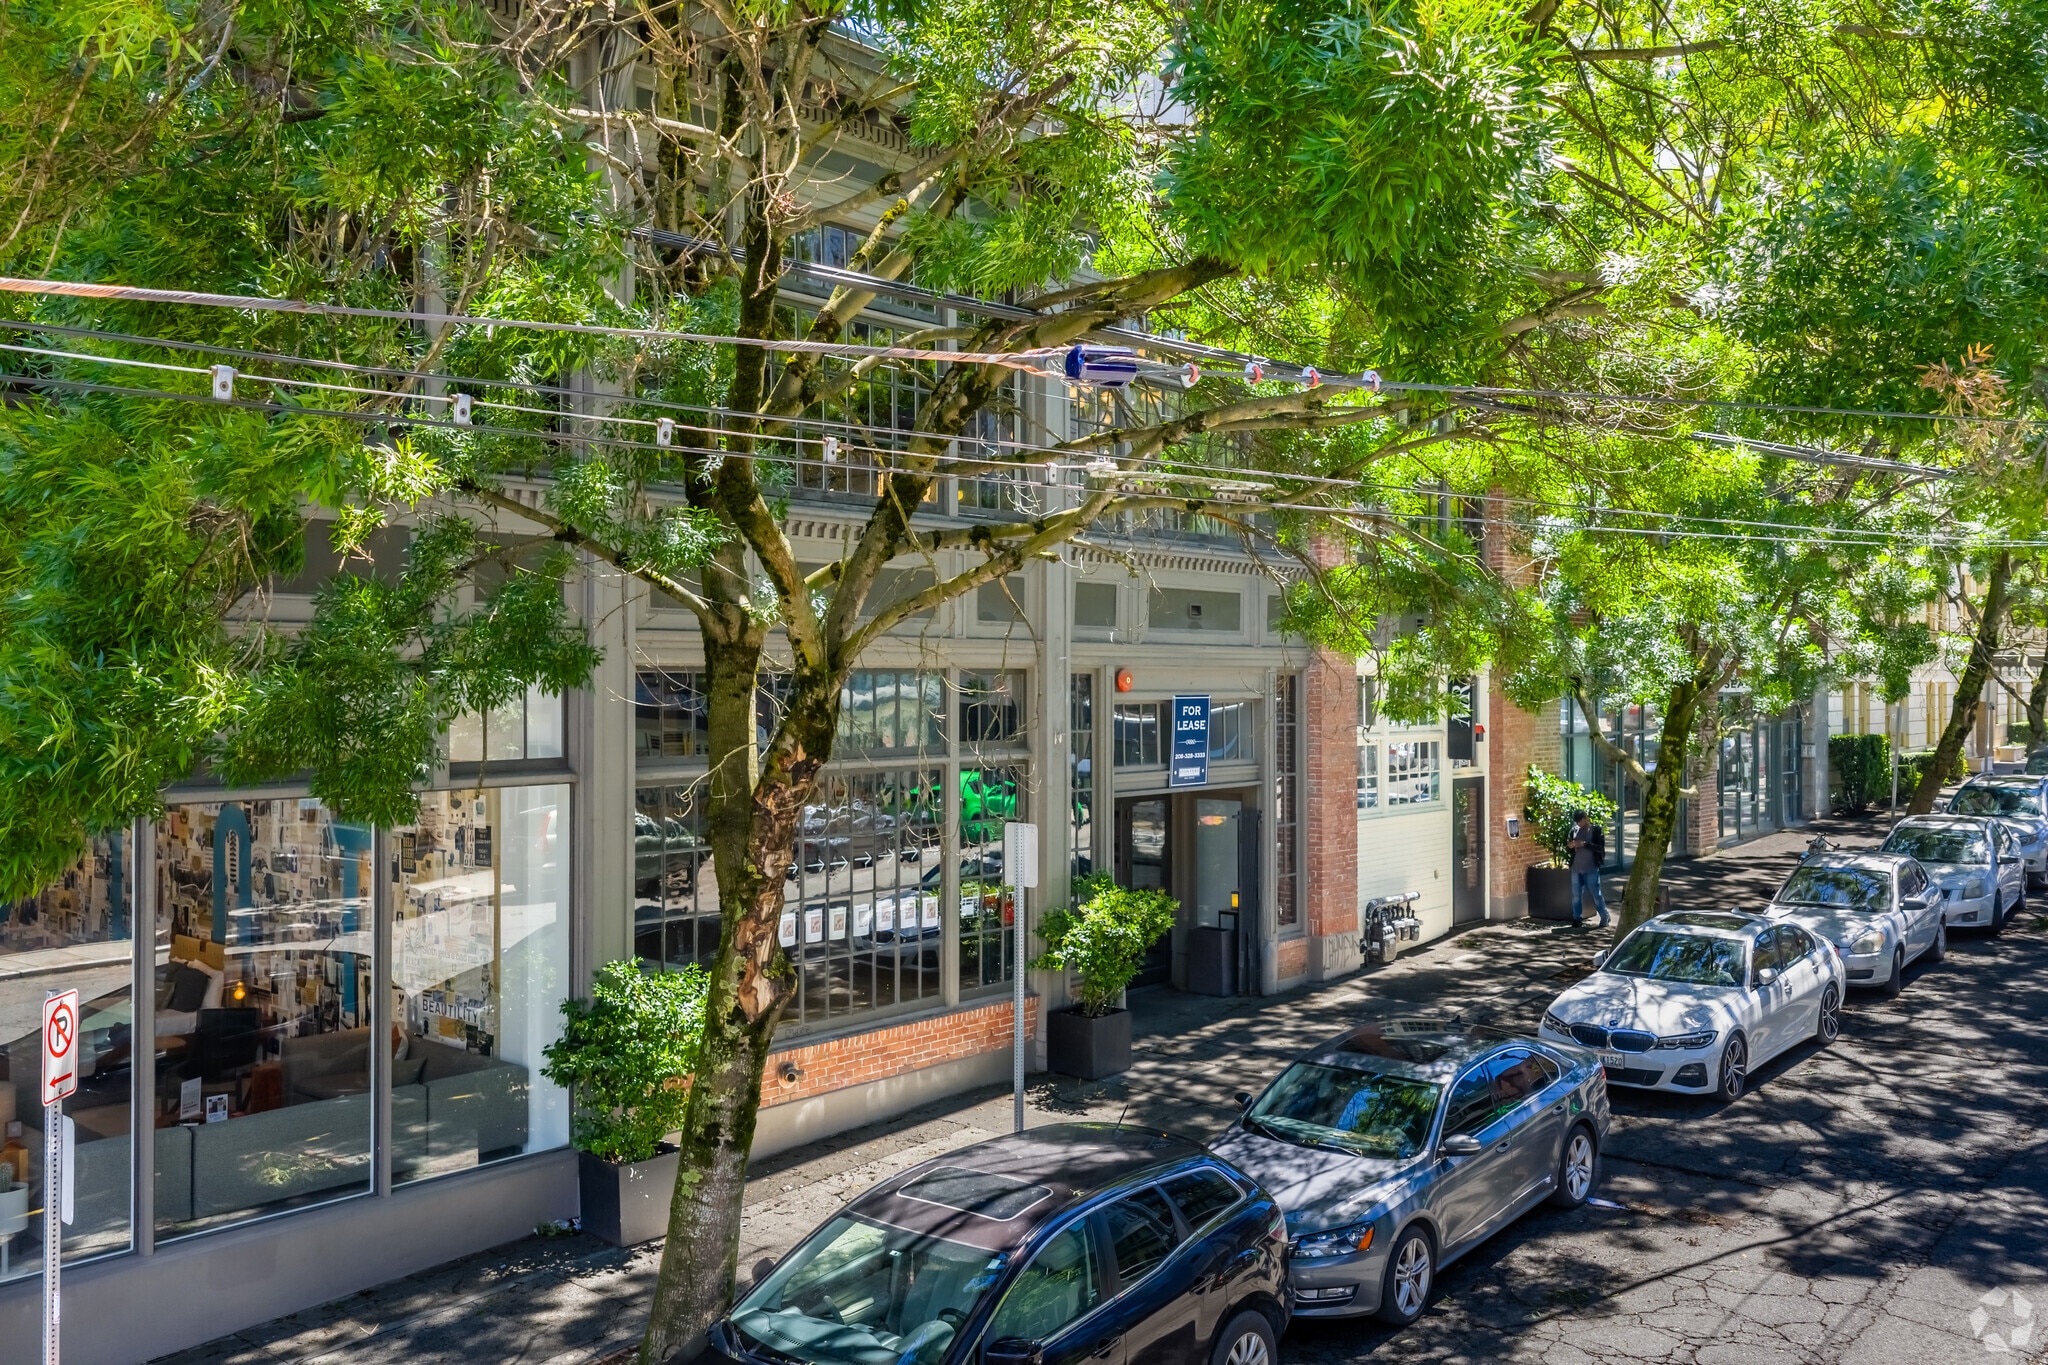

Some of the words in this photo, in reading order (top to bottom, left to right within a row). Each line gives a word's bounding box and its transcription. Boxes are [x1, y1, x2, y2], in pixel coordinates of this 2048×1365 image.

[1182, 705, 1201, 716] FOR
[1177, 720, 1206, 731] LEASE
[423, 999, 478, 1023] BEAUTILITY
